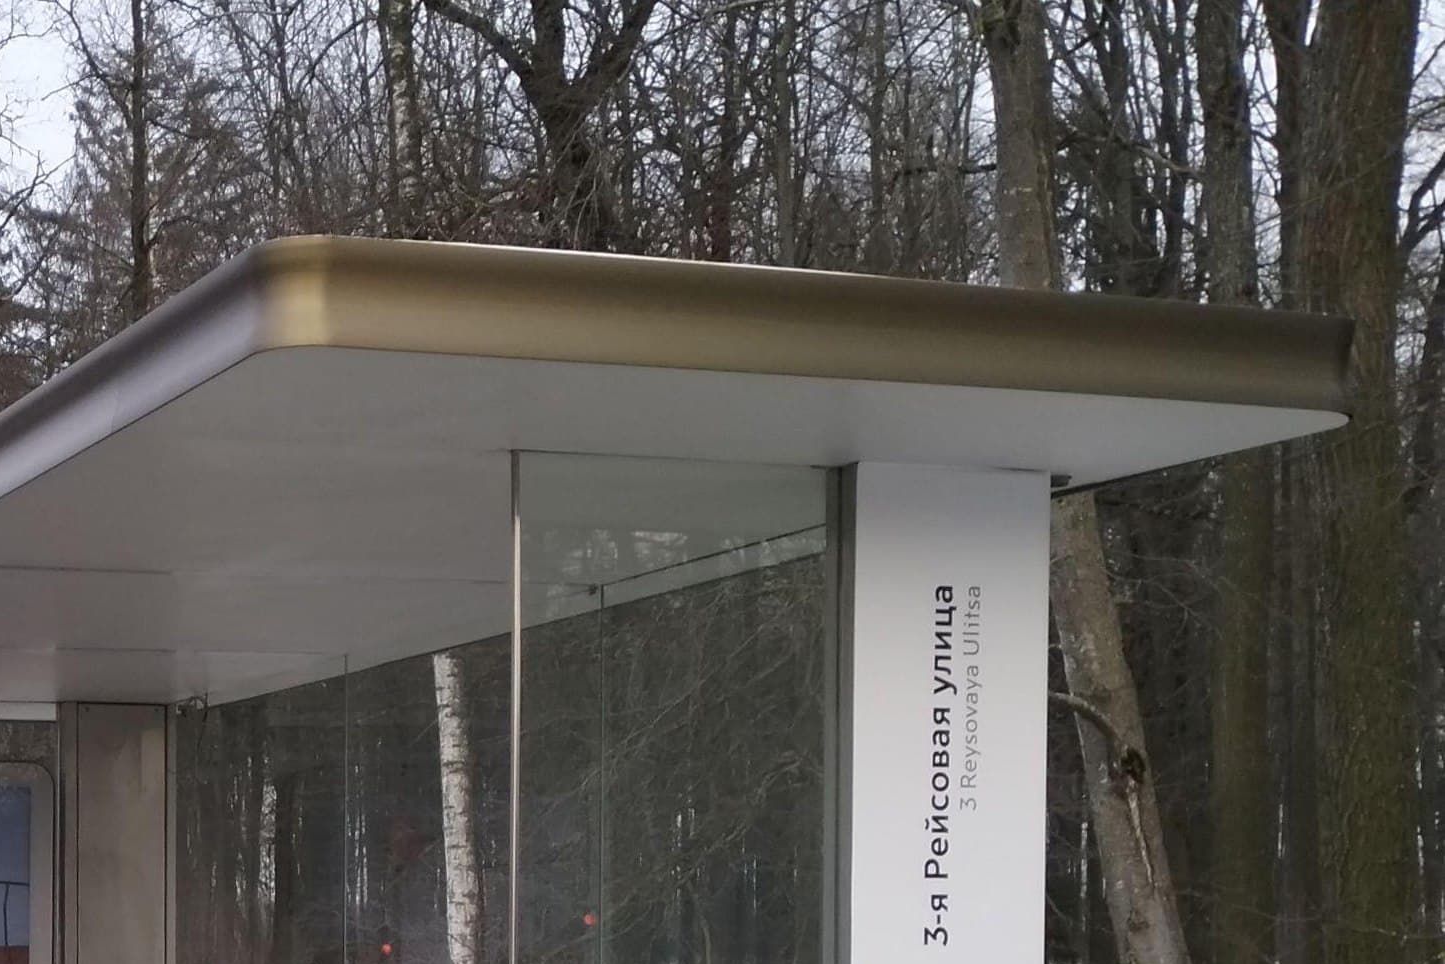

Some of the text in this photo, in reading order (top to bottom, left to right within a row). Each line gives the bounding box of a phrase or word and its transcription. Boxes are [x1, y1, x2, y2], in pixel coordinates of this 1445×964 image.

[924, 585, 957, 946] 3-я Рейсовая улица
[960, 585, 983, 811] 3 Reysovaya Ulitsa
